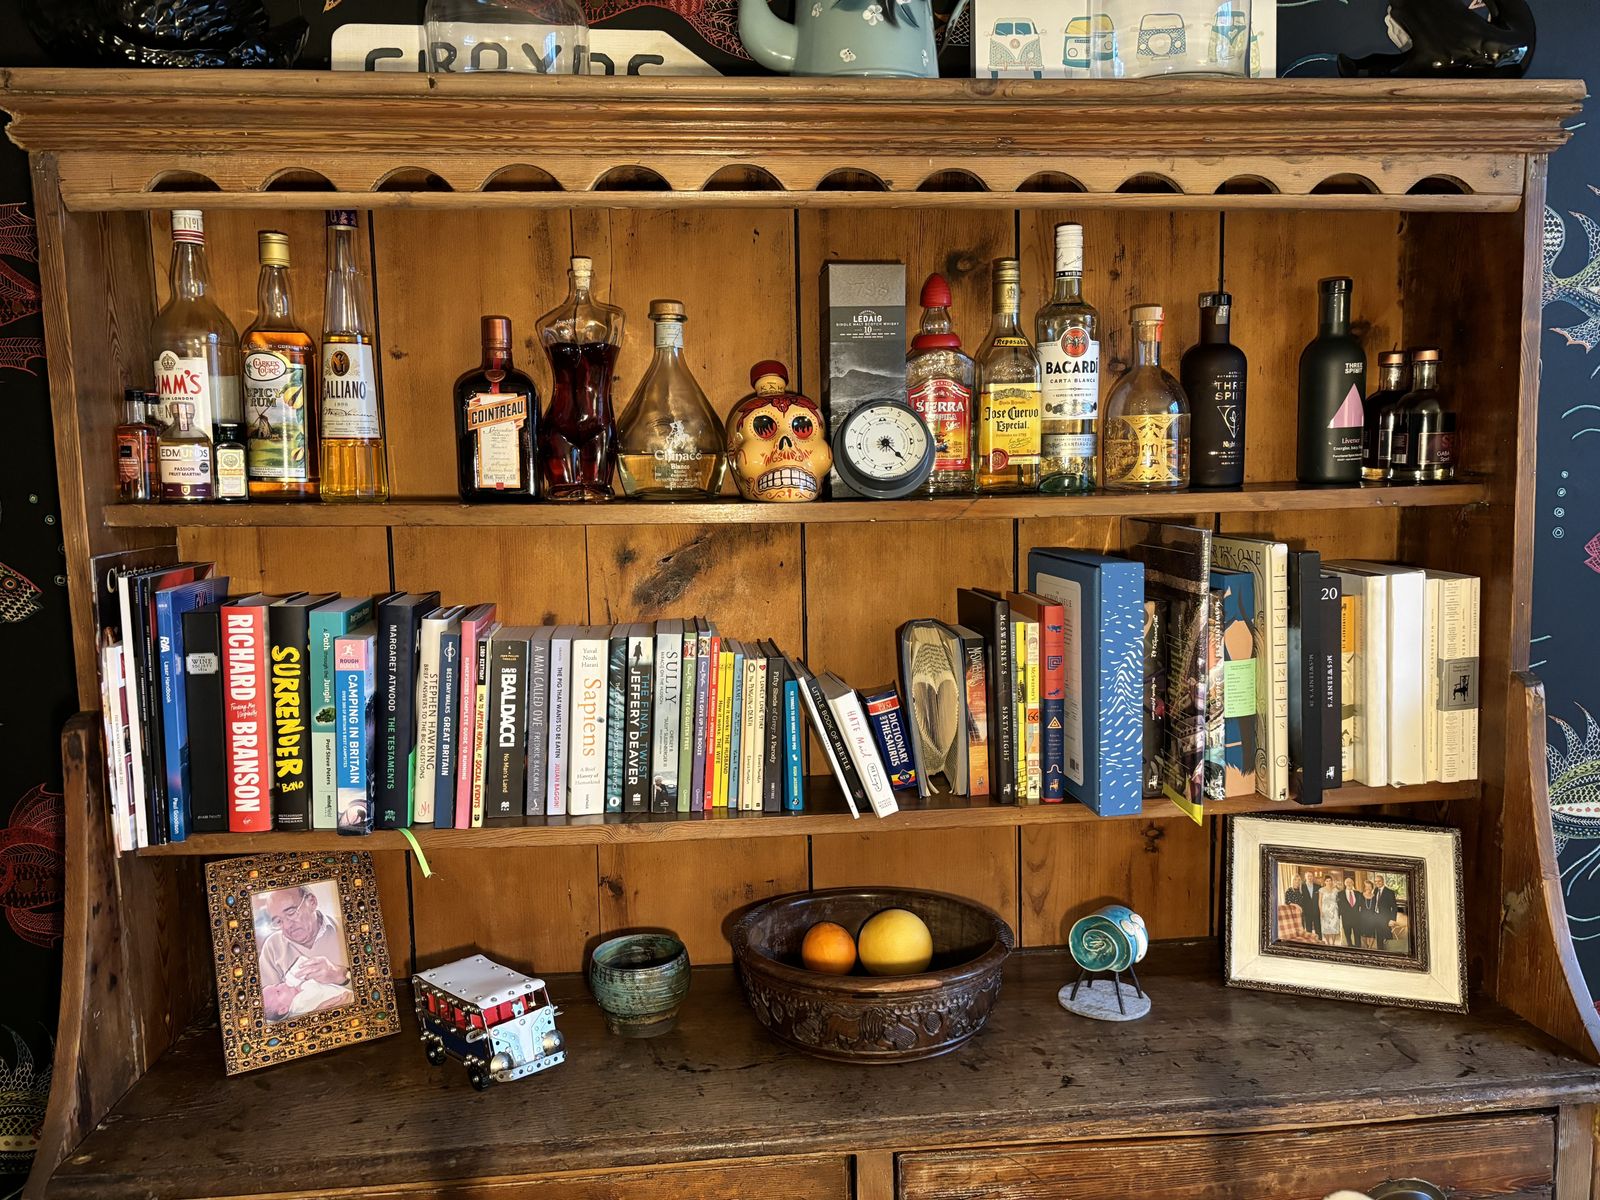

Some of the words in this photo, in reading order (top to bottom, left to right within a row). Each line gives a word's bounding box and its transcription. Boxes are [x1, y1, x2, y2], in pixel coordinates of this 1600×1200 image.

[853, 315, 883, 323] LEDAIG
[250, 398, 277, 408] RUM
[471, 400, 524, 425] COINTREAU
[916, 400, 965, 414] SIERRA
[984, 406, 1005, 421] Jose
[1008, 406, 1039, 419] Cuervo
[1320, 587, 1338, 600] 20
[160, 636, 171, 653] RYA
[228, 614, 256, 701] RICHARD
[389, 625, 397, 672] MARGARET
[534, 655, 544, 674] MAN
[665, 651, 678, 705] SULLY
[322, 679, 331, 703] Jungle
[348, 675, 360, 724] CAMPING
[388, 675, 397, 711] ATWOOD
[428, 673, 438, 717] STEPHEN
[533, 677, 544, 707] CALLED
[630, 668, 641, 727] JEFFERY
[641, 673, 649, 697] THE
[271, 645, 306, 779] SURRENDER
[422, 711, 428, 719] TO
[499, 674, 517, 747] BALDACCI
[532, 711, 543, 727] OVE
[577, 678, 603, 757] Sapiens
[640, 702, 649, 737] FINAL
[685, 706, 690, 715] GO
[698, 717, 704, 726] UP
[770, 716, 778, 733] Grey:
[847, 710, 860, 732] HATE
[349, 727, 359, 738] IN
[443, 717, 451, 741] GREAT
[555, 724, 561, 733] TO
[555, 733, 561, 741] BE
[812, 686, 824, 709] LITTLE
[822, 710, 833, 730] BOOK
[830, 730, 838, 740] OF
[835, 741, 850, 771] BEETLE
[880, 720, 900, 767] THESAURUS
[888, 712, 910, 763] DICTIONARY
[1002, 706, 1010, 762] SIXTY-EIGHT
[426, 721, 437, 770] HAWKING
[441, 745, 450, 776] BRITAIN
[463, 746, 468, 754] TO
[503, 753, 510, 762] No
[629, 732, 639, 785] DEAVER
[769, 741, 777, 763] Parody
[231, 721, 261, 813] BRANSON
[350, 741, 360, 783] BRITAIN
[387, 736, 395, 789] TESTAMENTS
[419, 745, 427, 779] QUESTIONS
[532, 759, 540, 792] BACKMAN
[639, 742, 648, 780] TWIST
[282, 780, 304, 794] BONO
